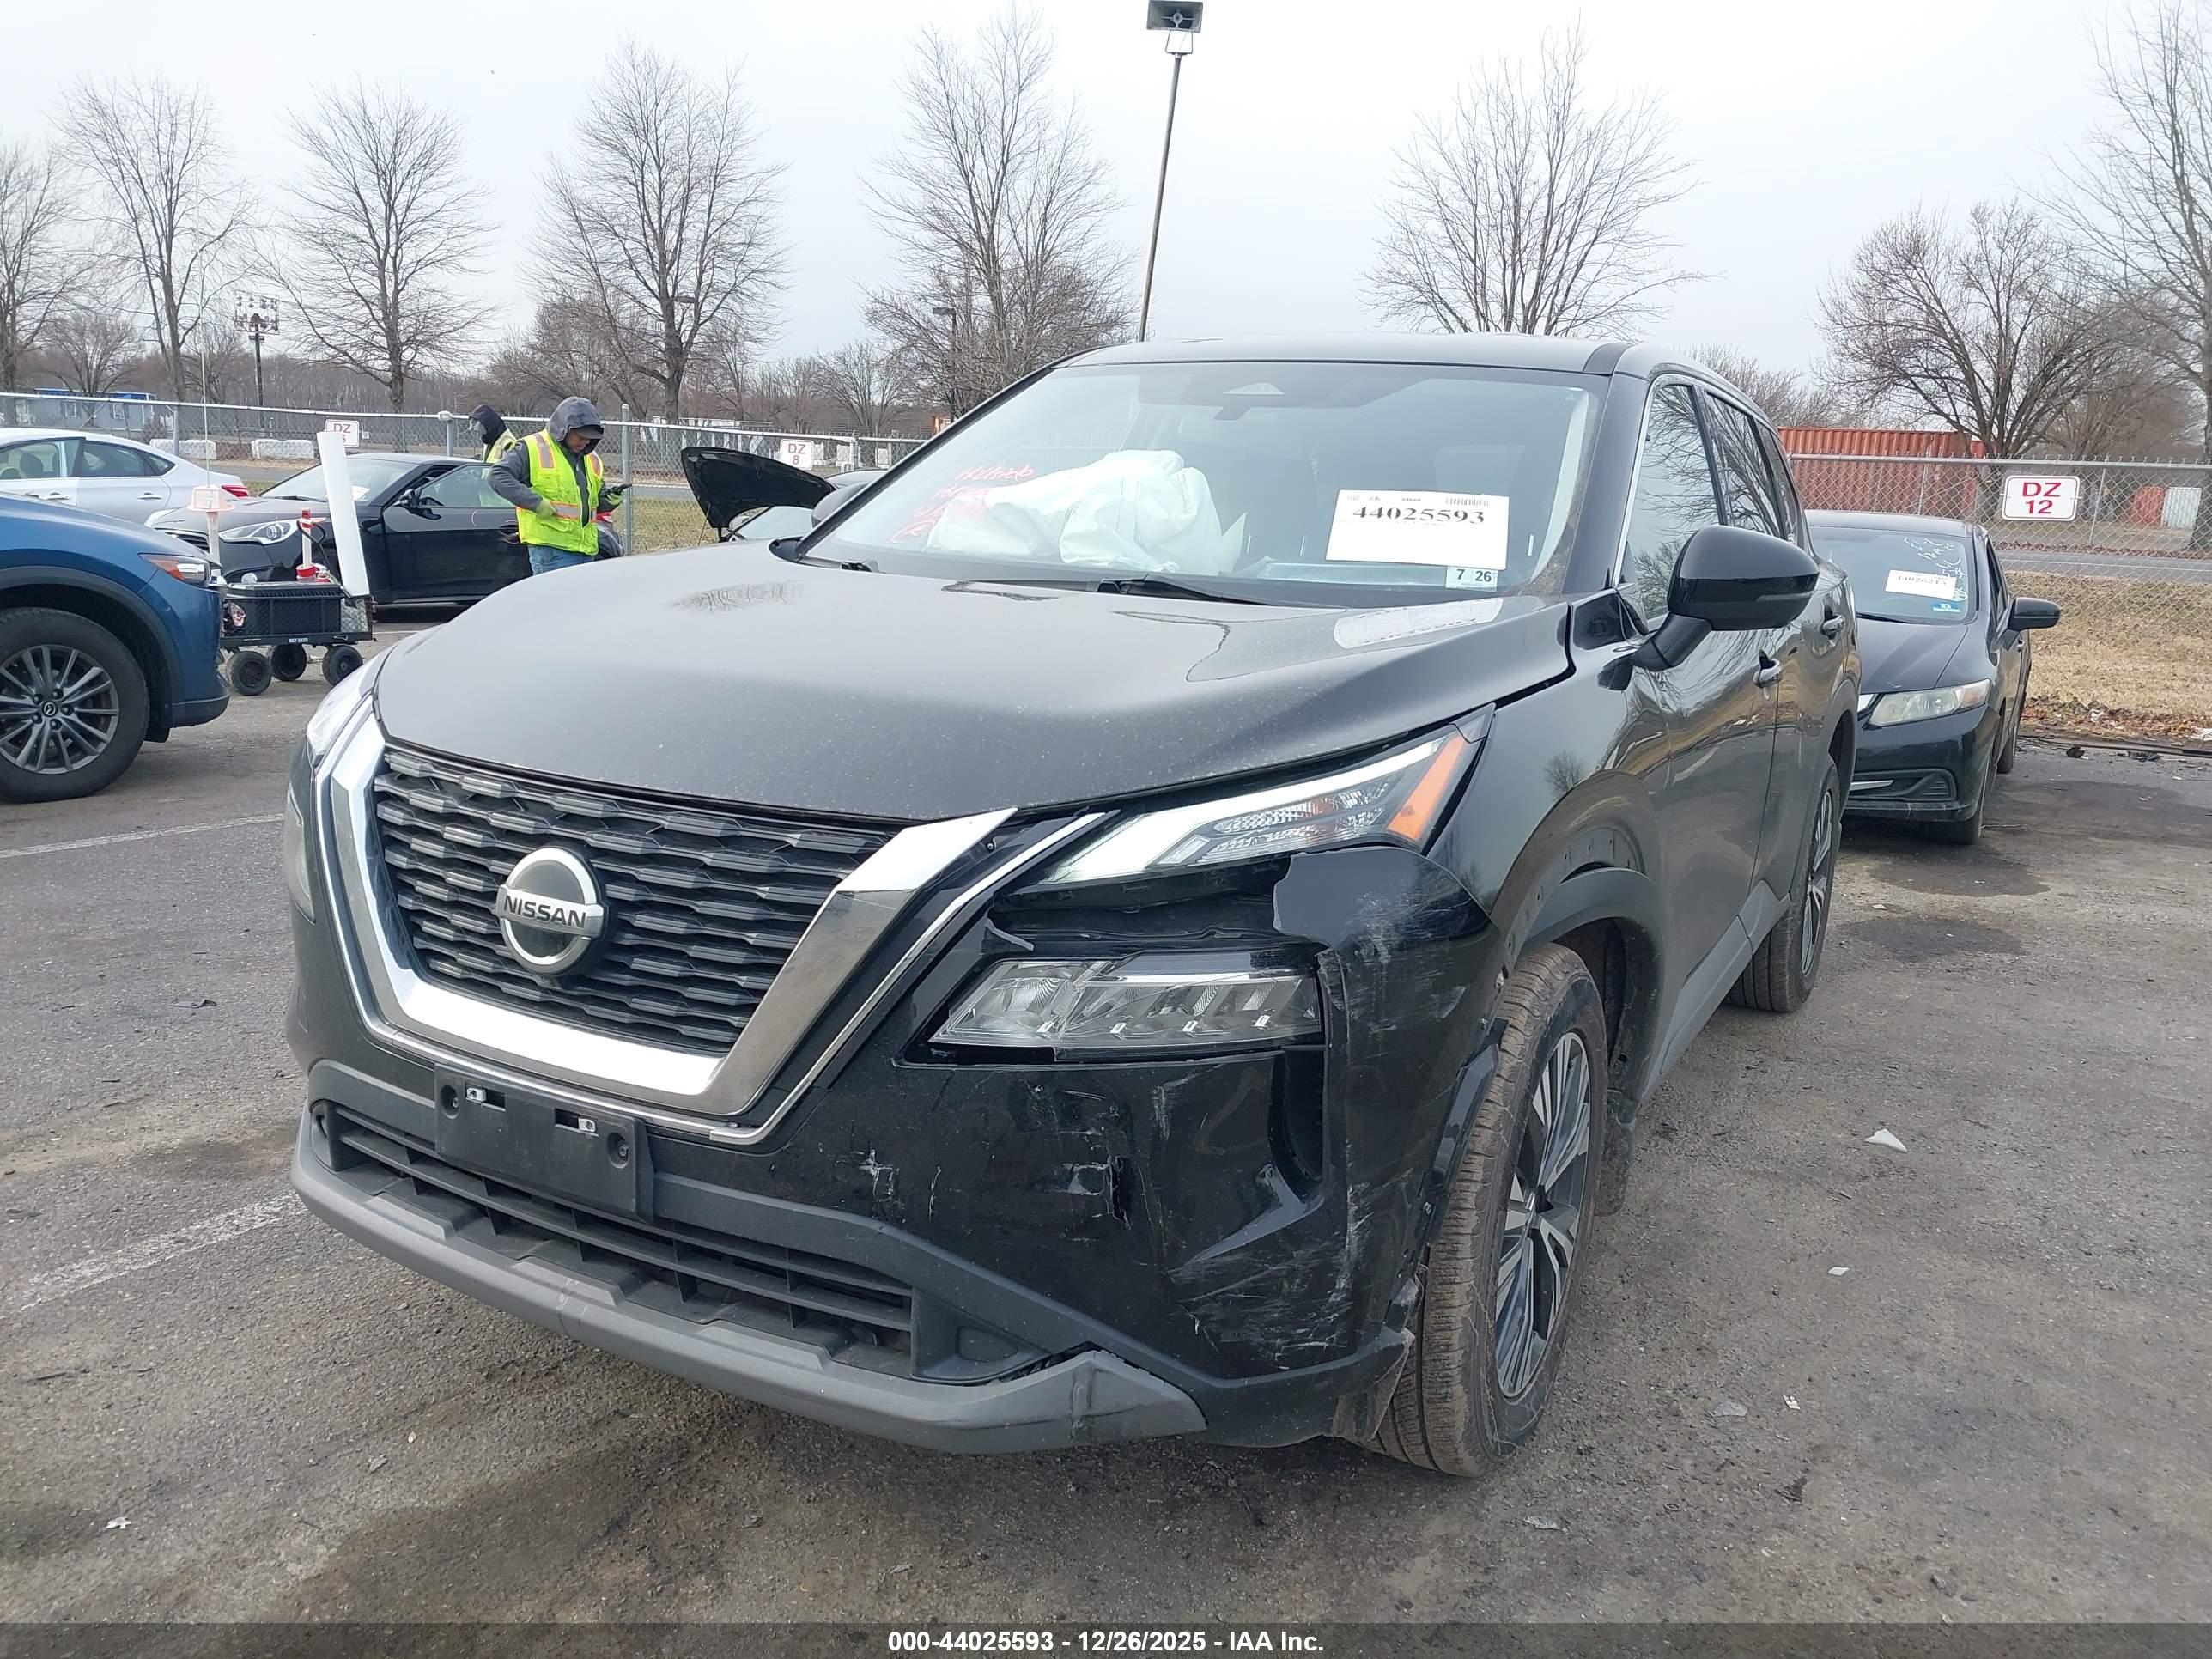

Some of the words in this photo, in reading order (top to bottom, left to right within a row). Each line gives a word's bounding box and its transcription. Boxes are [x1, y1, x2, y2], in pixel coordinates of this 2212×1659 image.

[333, 423, 351, 434] DZ
[787, 443, 806, 454] DZ
[792, 454, 799, 465] 8
[2022, 482, 2062, 497] DZ
[2025, 500, 2053, 514] 12
[1352, 506, 1485, 525] 44025593
[1456, 568, 1465, 580] 7
[1475, 570, 1492, 582] 26
[504, 895, 586, 928] NISSAN
